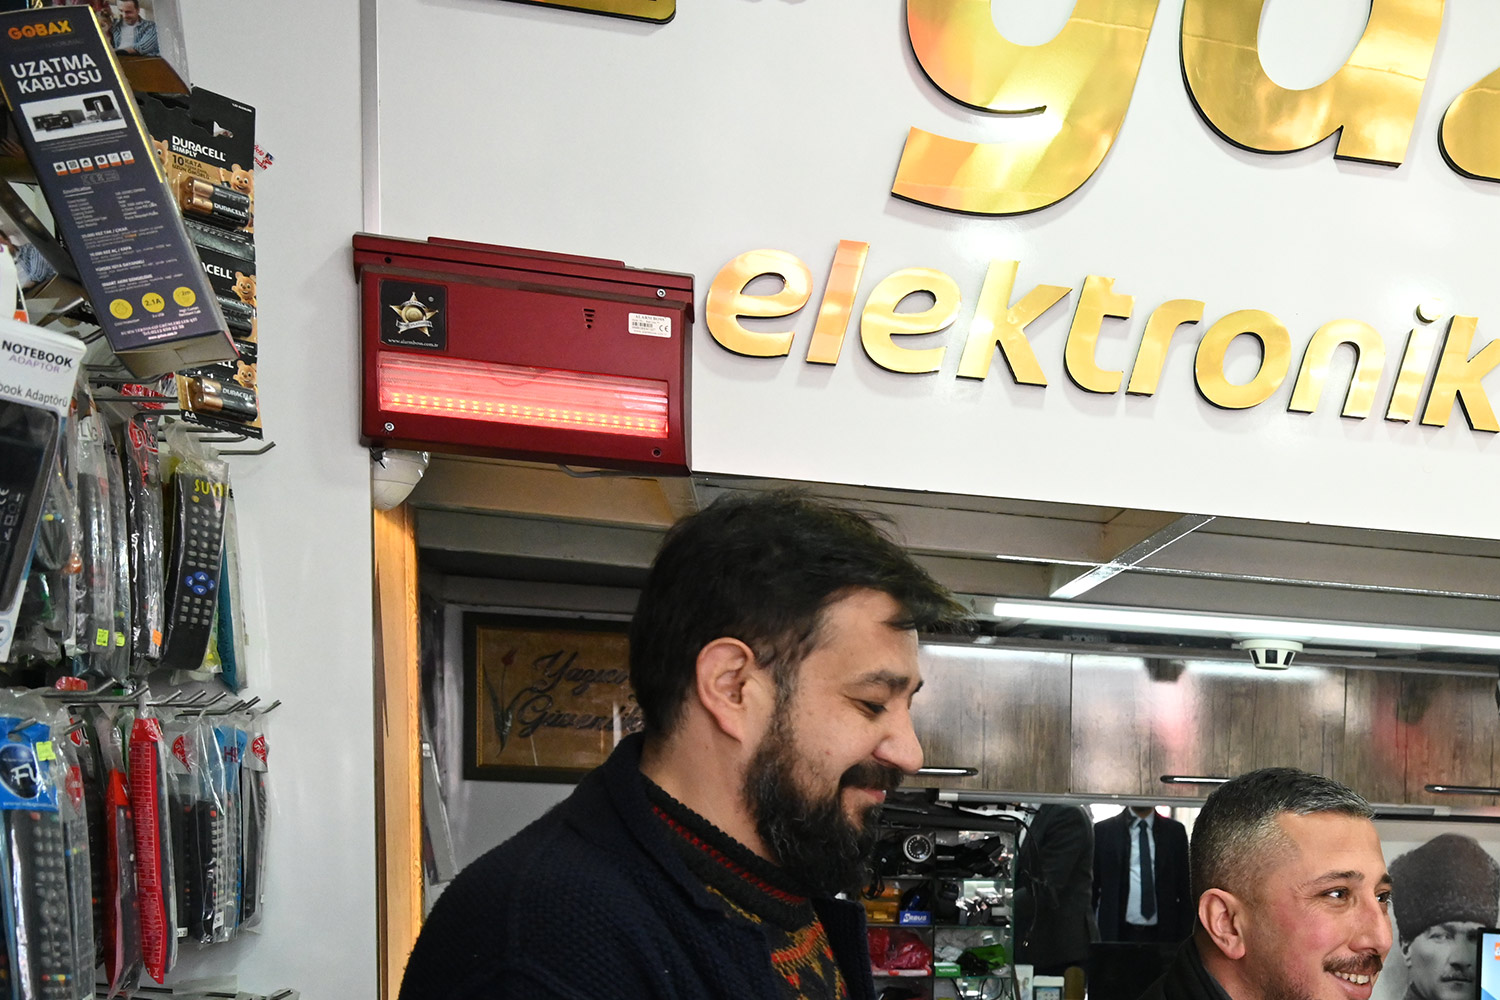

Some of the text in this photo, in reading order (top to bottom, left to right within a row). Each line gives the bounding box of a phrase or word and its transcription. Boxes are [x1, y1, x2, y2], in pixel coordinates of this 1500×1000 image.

[8, 20, 72, 40] GOBAX
[10, 53, 97, 79] UZATMA
[17, 69, 102, 94] KABLOSU
[172, 135, 226, 162] DURACELL
[172, 145, 198, 158] SIMPLY
[172, 154, 185, 166] 10
[213, 202, 247, 218] DURACELL
[201, 262, 232, 280] CELL
[144, 297, 161, 307] 2.1A
[1, 340, 73, 369] NOTEBOOK
[25, 387, 68, 408] Adaptörü
[222, 387, 254, 401] DURACELL
[184, 411, 197, 420] AA
